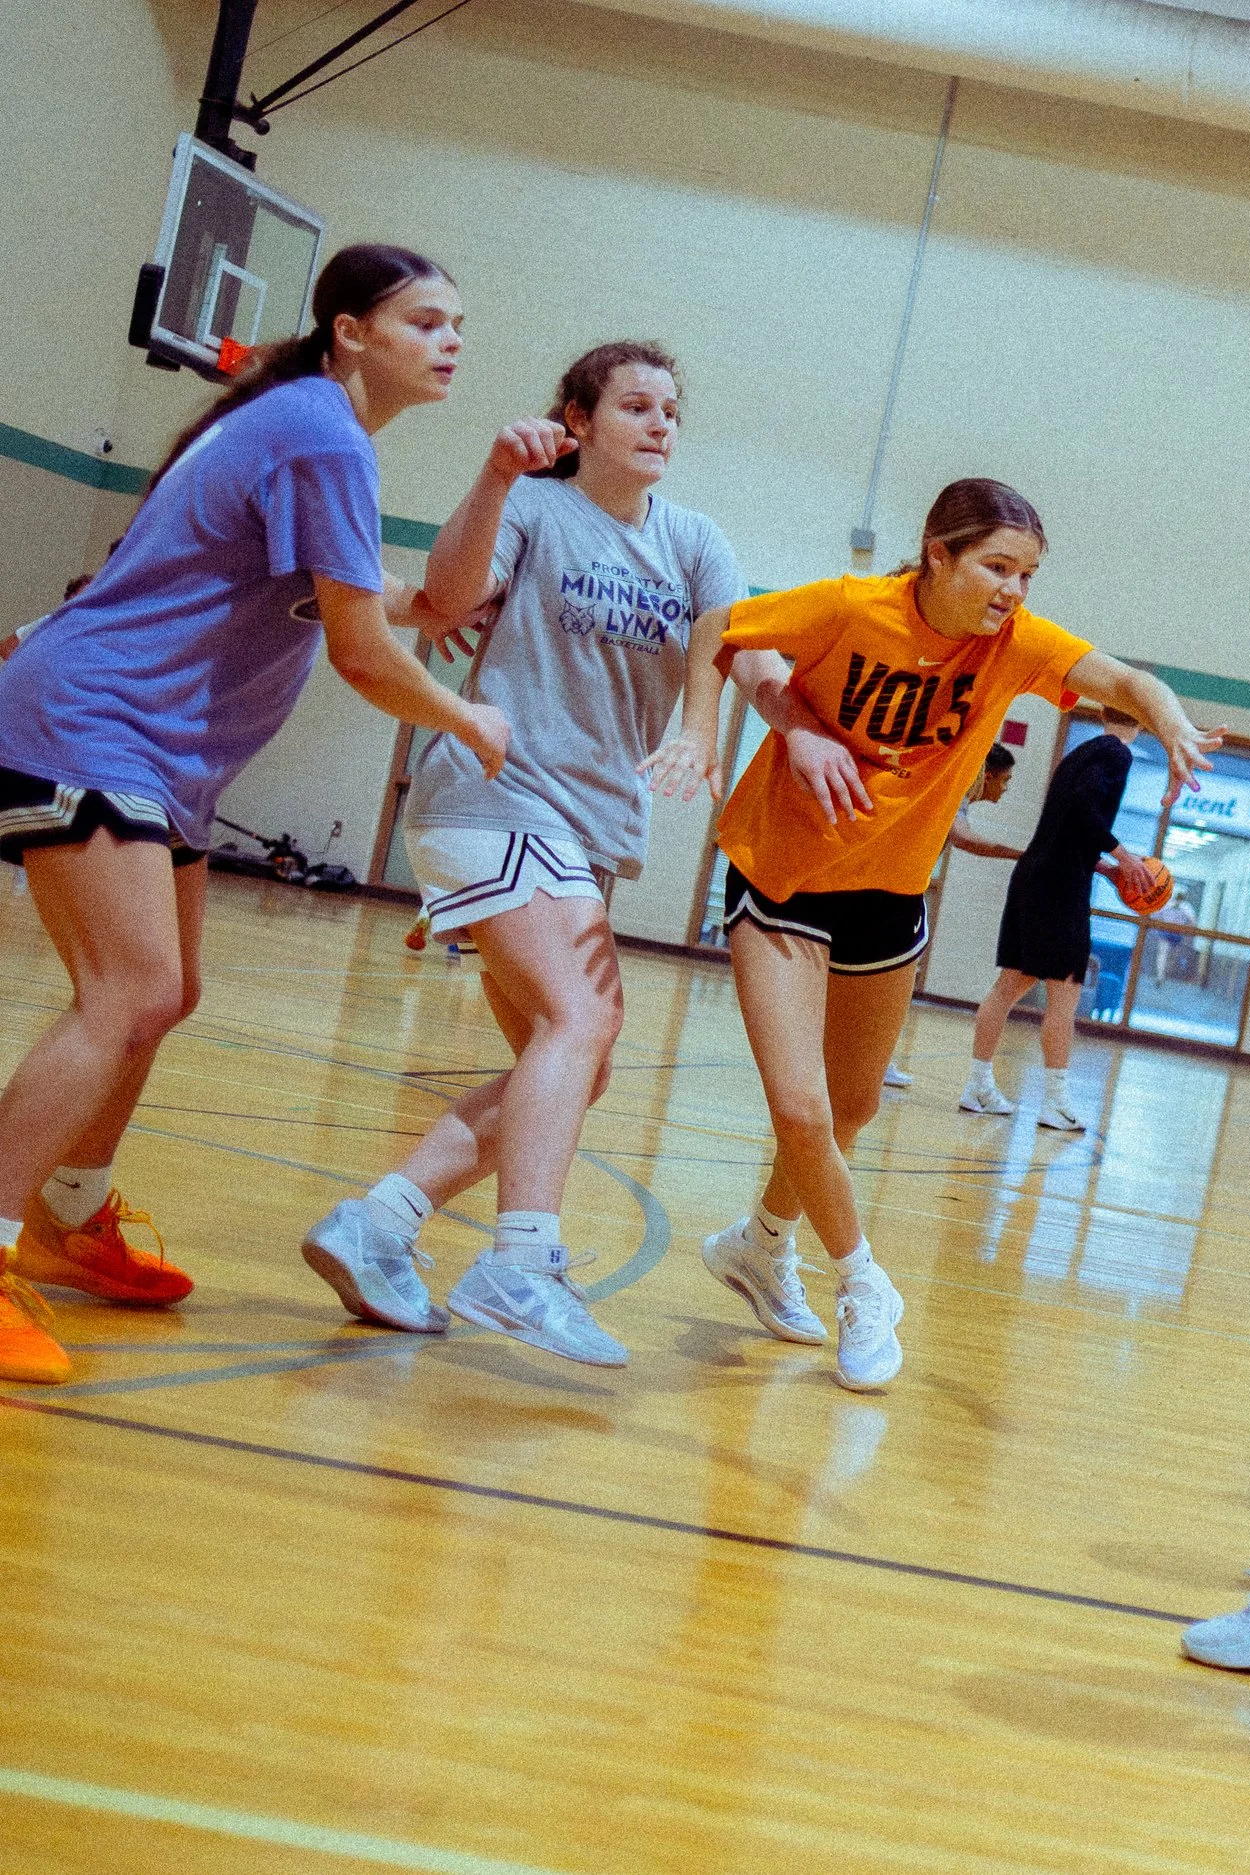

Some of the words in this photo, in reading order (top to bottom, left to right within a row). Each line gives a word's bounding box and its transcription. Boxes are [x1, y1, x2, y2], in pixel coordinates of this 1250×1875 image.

[592, 561, 664, 590] PROPTY
[605, 608, 669, 644] LYNX
[837, 651, 976, 747] VOLS
